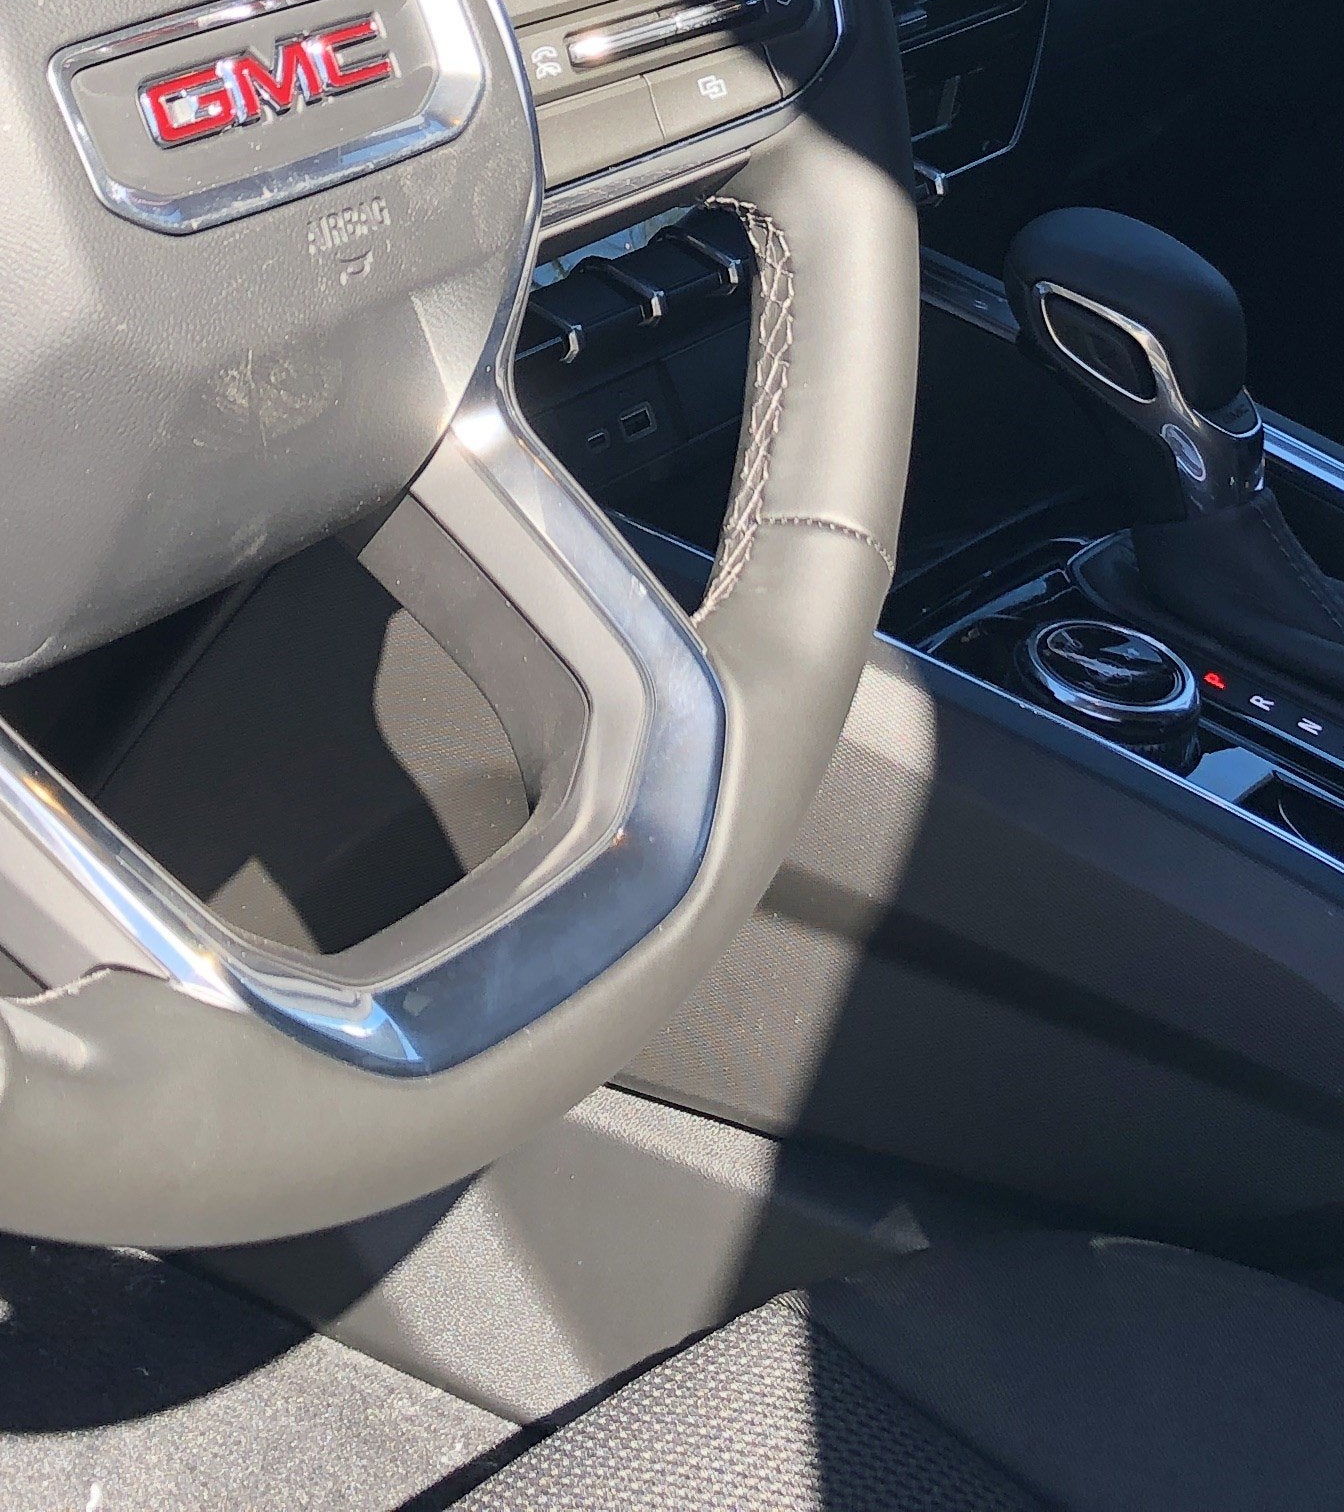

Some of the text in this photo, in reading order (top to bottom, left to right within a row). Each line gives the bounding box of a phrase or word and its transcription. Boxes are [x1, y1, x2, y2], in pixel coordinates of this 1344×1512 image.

[140, 11, 400, 149] GMC
[307, 195, 391, 256] AIRBAG
[1203, 672, 1225, 689] P
[1250, 694, 1275, 710] R
[1297, 717, 1323, 735] N
